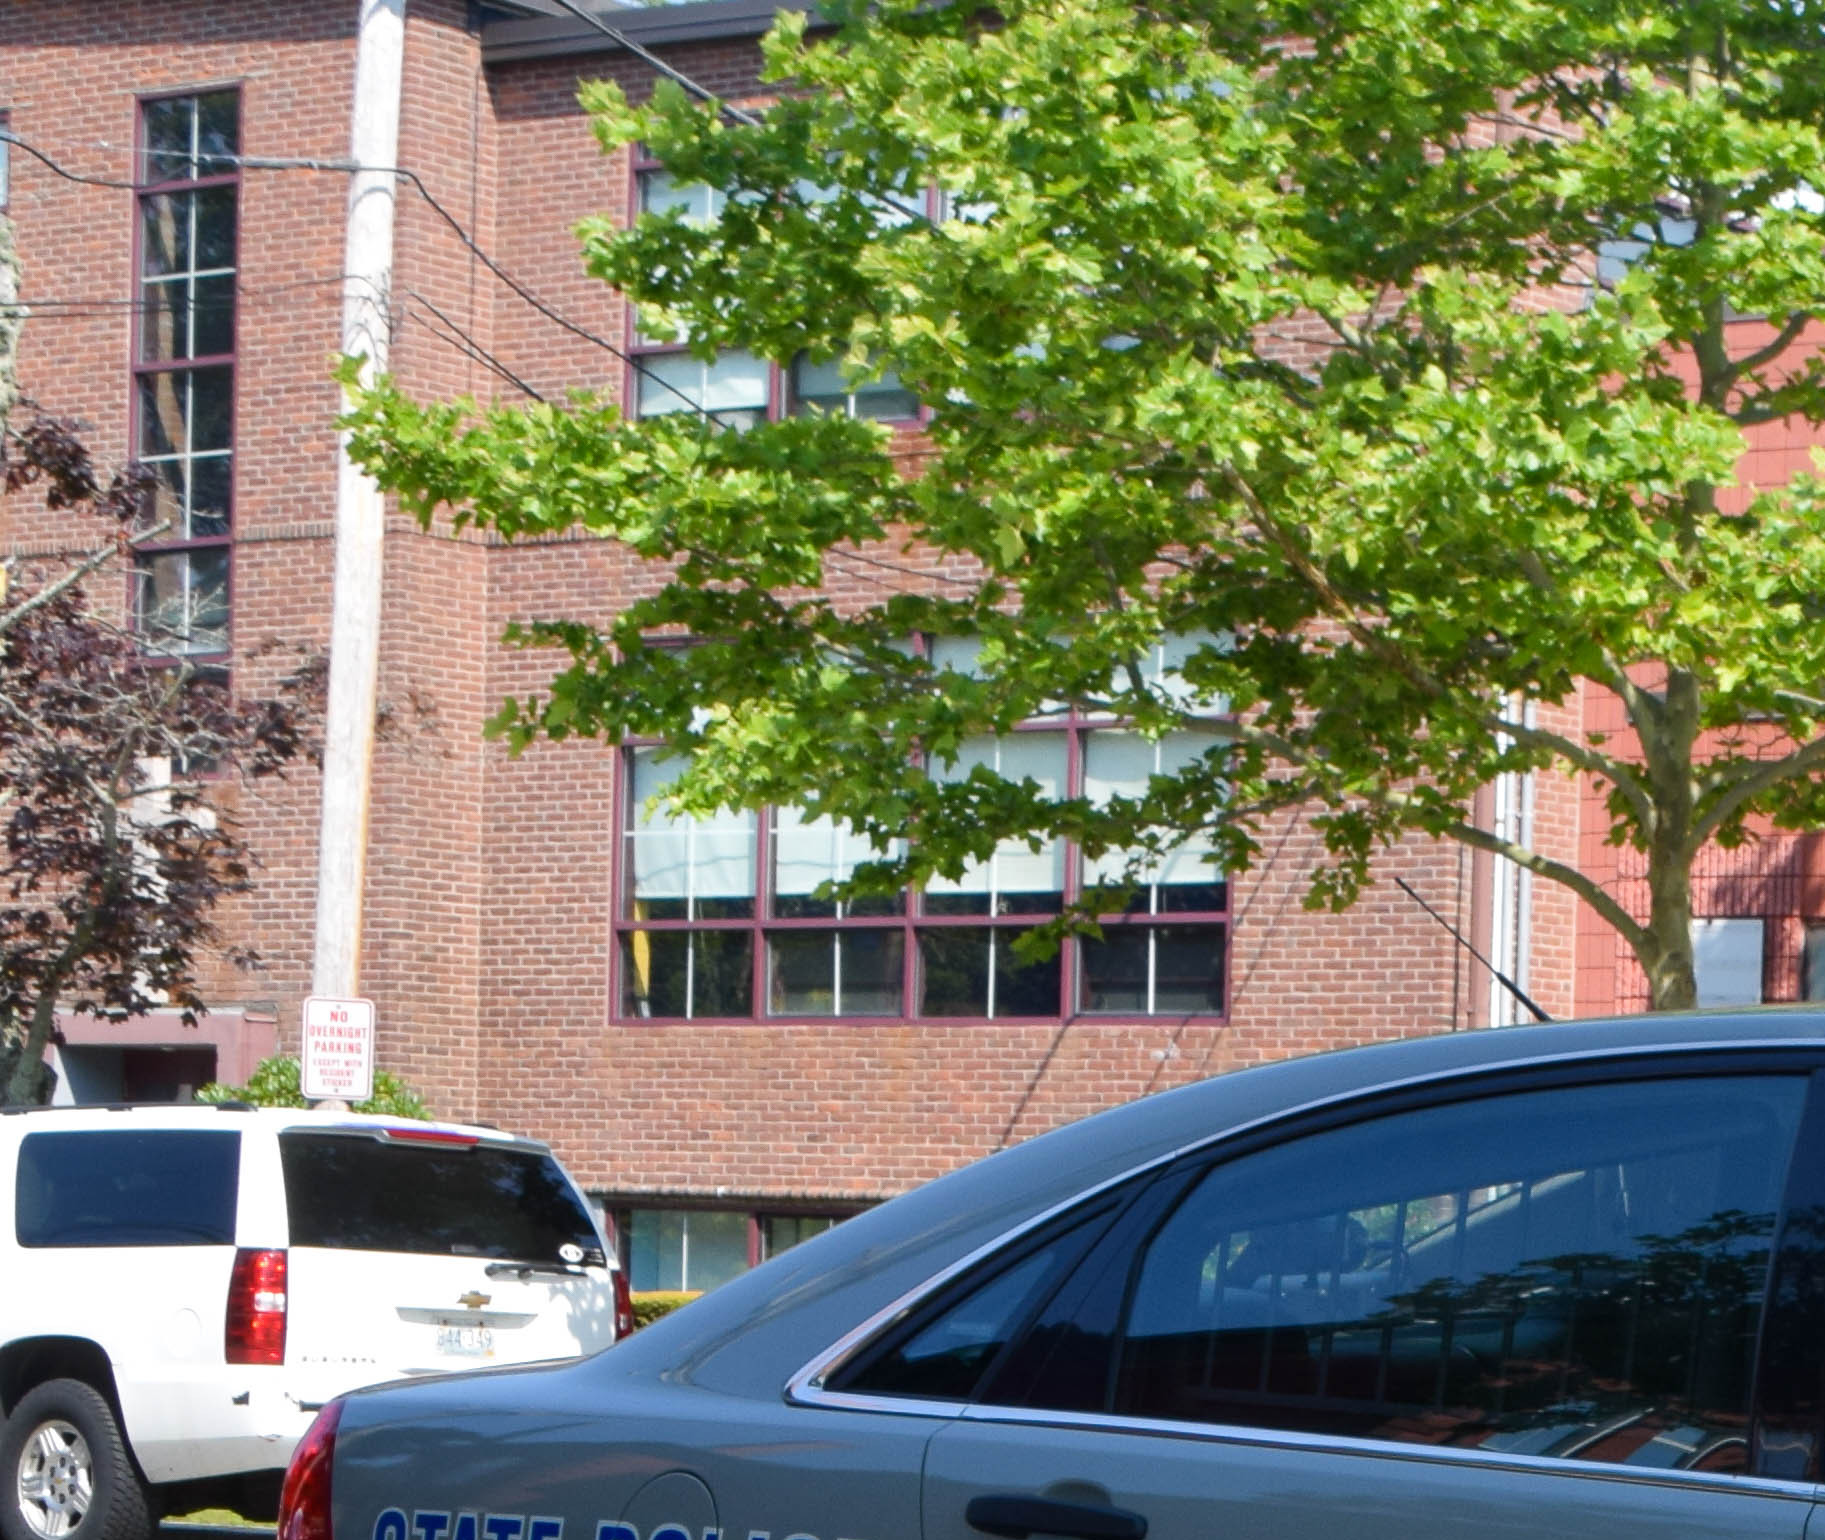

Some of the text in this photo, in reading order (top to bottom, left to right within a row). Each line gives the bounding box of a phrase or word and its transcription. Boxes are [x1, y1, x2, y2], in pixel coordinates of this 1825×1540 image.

[330, 1011, 348, 1022] NO
[309, 1024, 368, 1039] OVERNIGHT
[315, 1040, 362, 1054] PARKING
